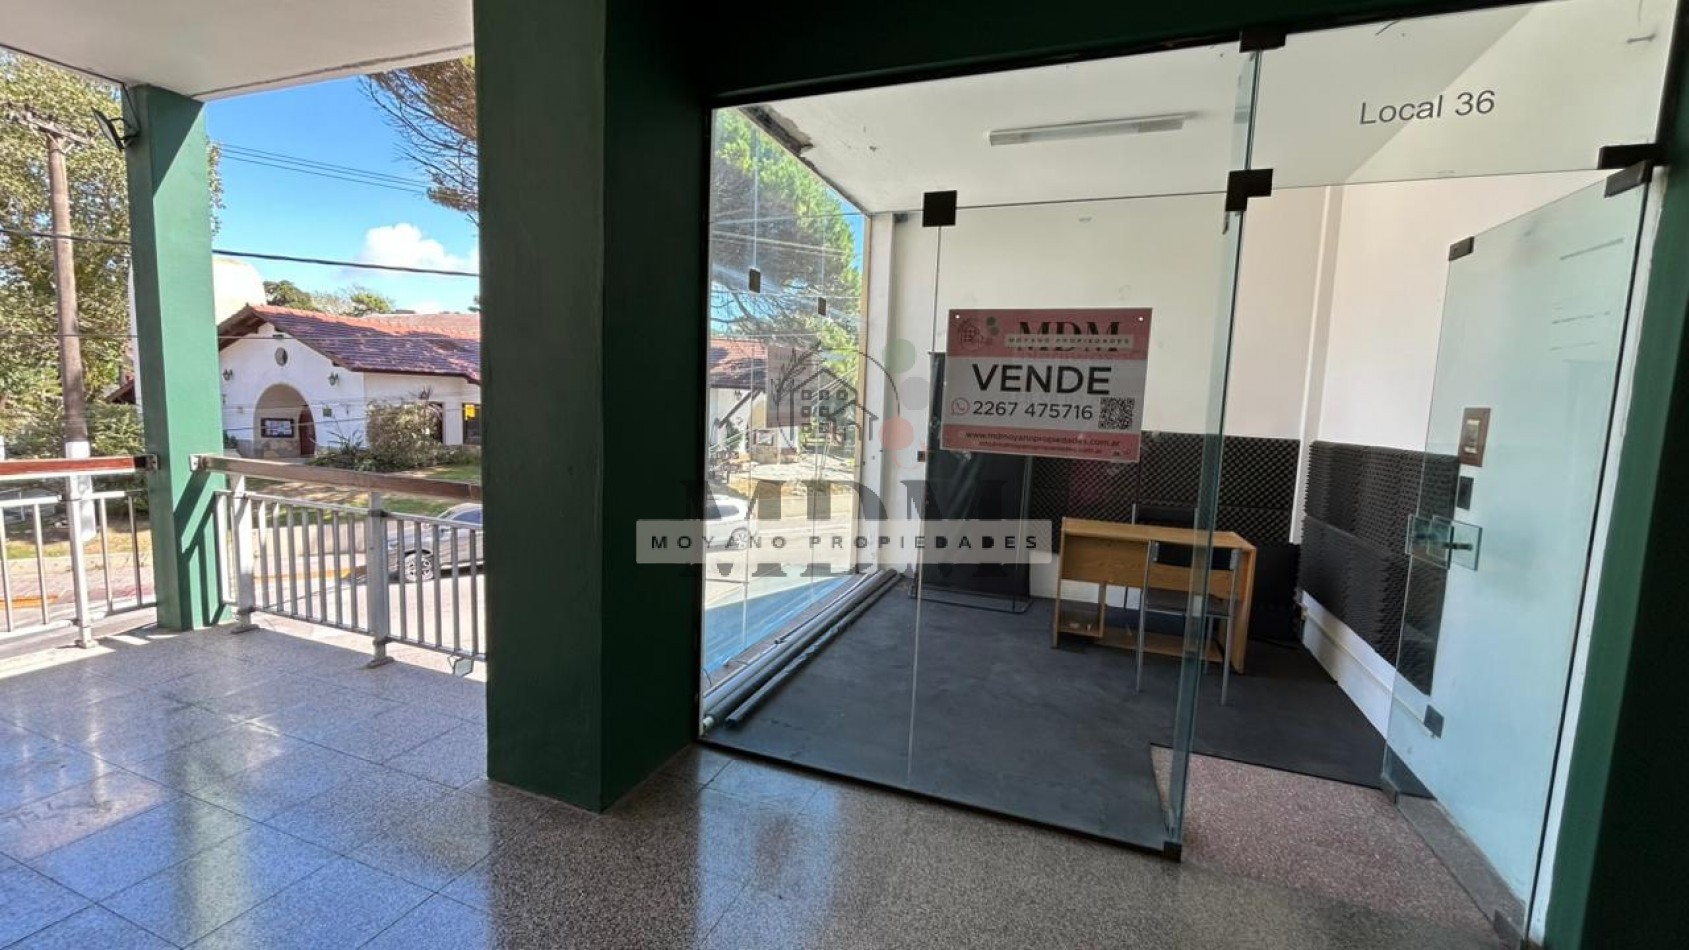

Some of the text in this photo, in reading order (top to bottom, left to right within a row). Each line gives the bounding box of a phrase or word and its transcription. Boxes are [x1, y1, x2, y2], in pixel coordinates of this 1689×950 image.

[1359, 90, 1496, 125] Local 36
[1009, 321, 1121, 352] MDM
[971, 363, 1112, 395] VENDE
[972, 400, 1094, 420] 2267 475716
